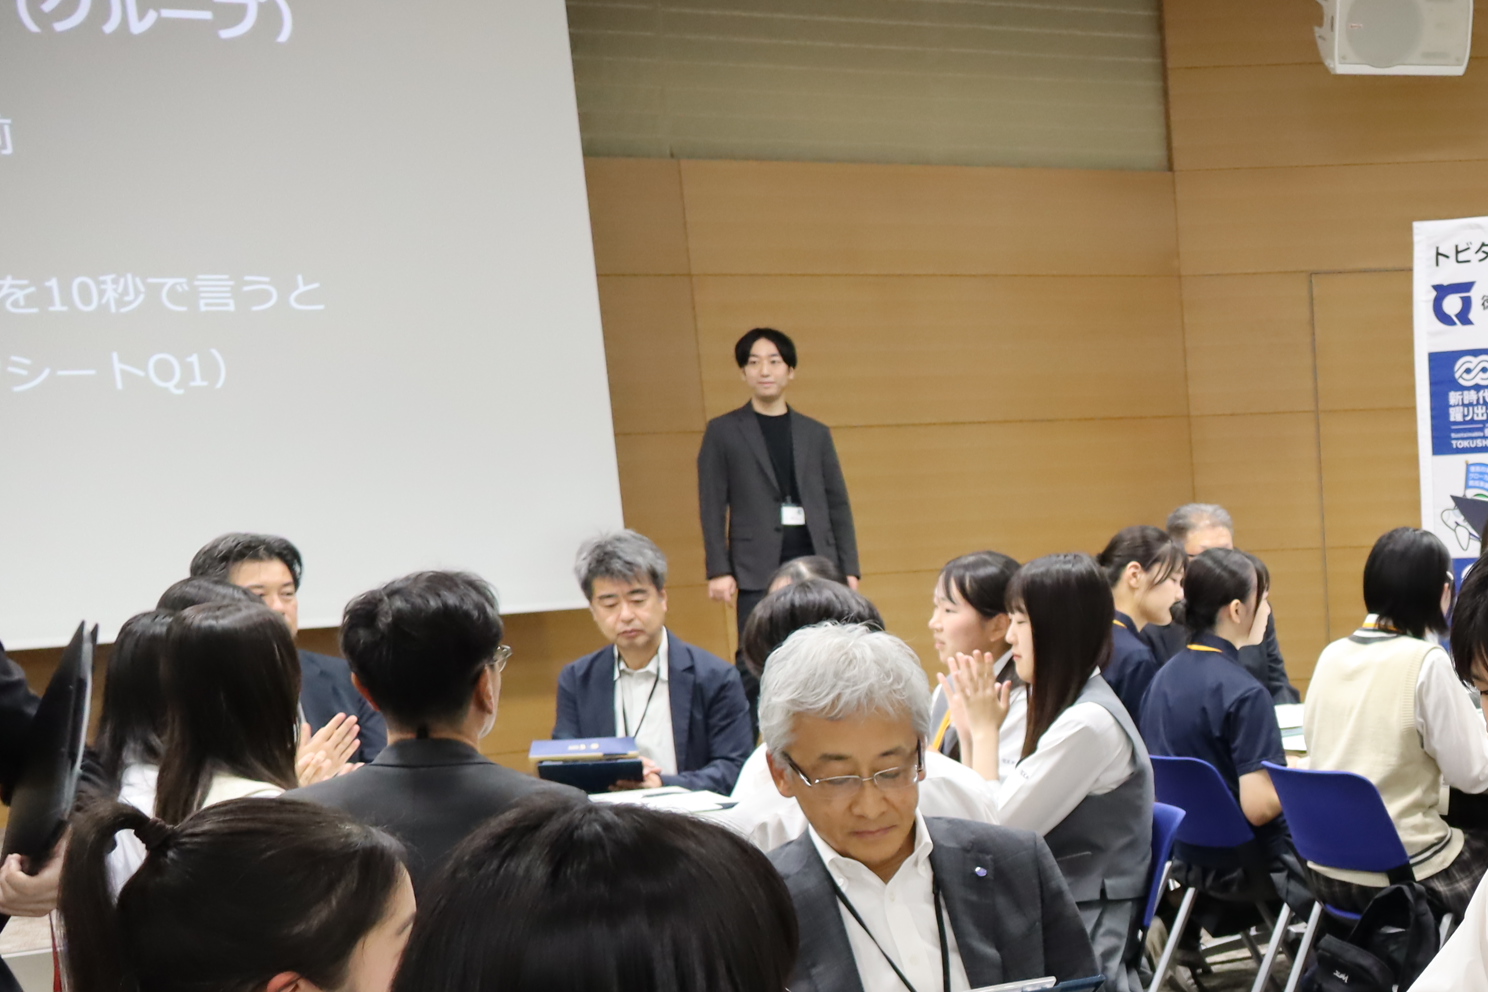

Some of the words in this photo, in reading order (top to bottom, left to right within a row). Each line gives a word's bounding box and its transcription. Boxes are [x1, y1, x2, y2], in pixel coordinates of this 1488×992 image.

[0, 273, 325, 314] を10秒で言うと
